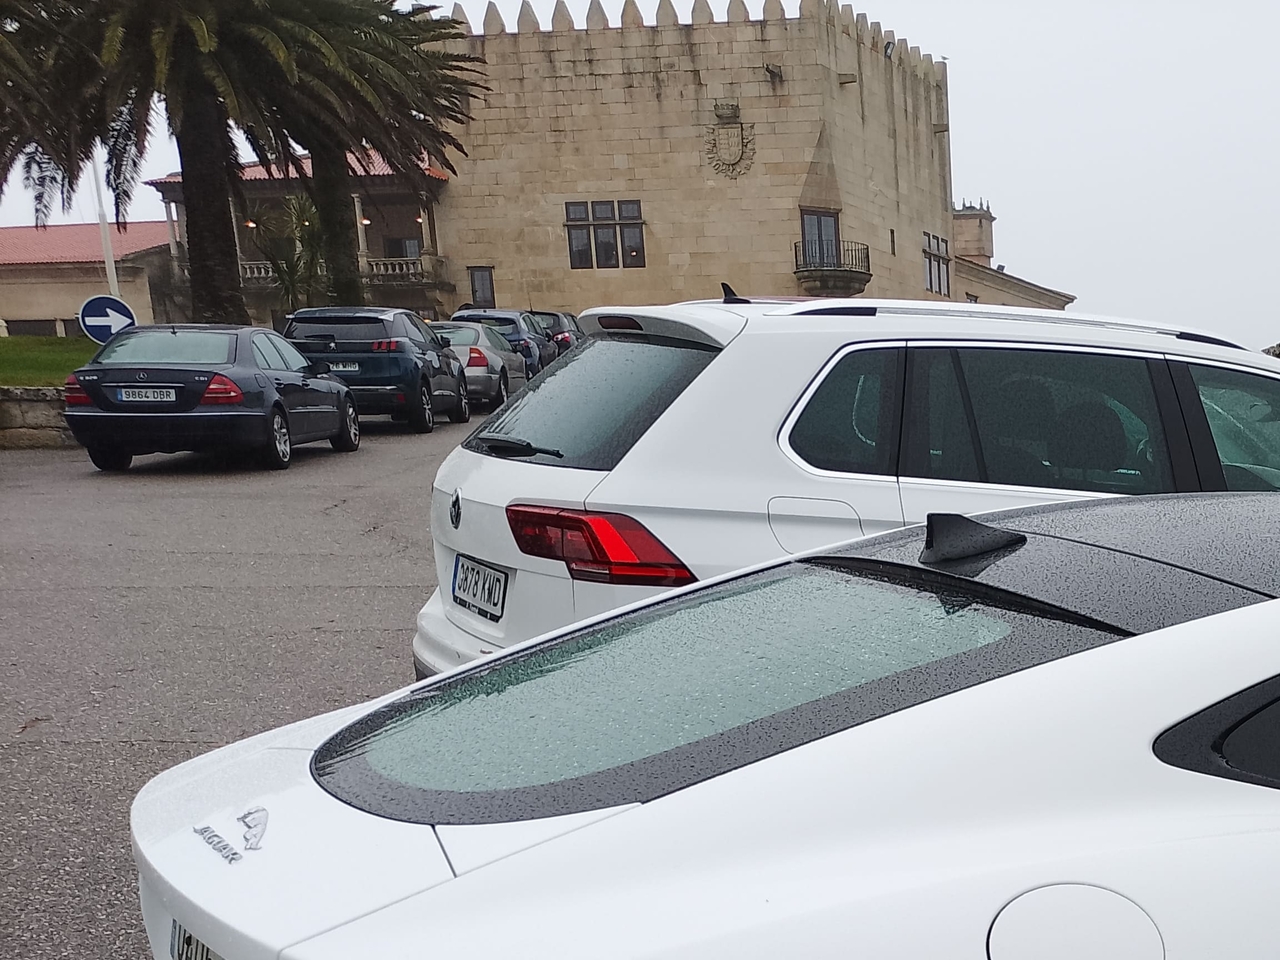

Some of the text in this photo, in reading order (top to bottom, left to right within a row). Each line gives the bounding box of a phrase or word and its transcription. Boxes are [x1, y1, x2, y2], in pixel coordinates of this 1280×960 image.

[124, 388, 172, 400] 9864 DBR
[458, 563, 501, 608] 3878 KMD
[192, 825, 244, 865] JAGUAR
